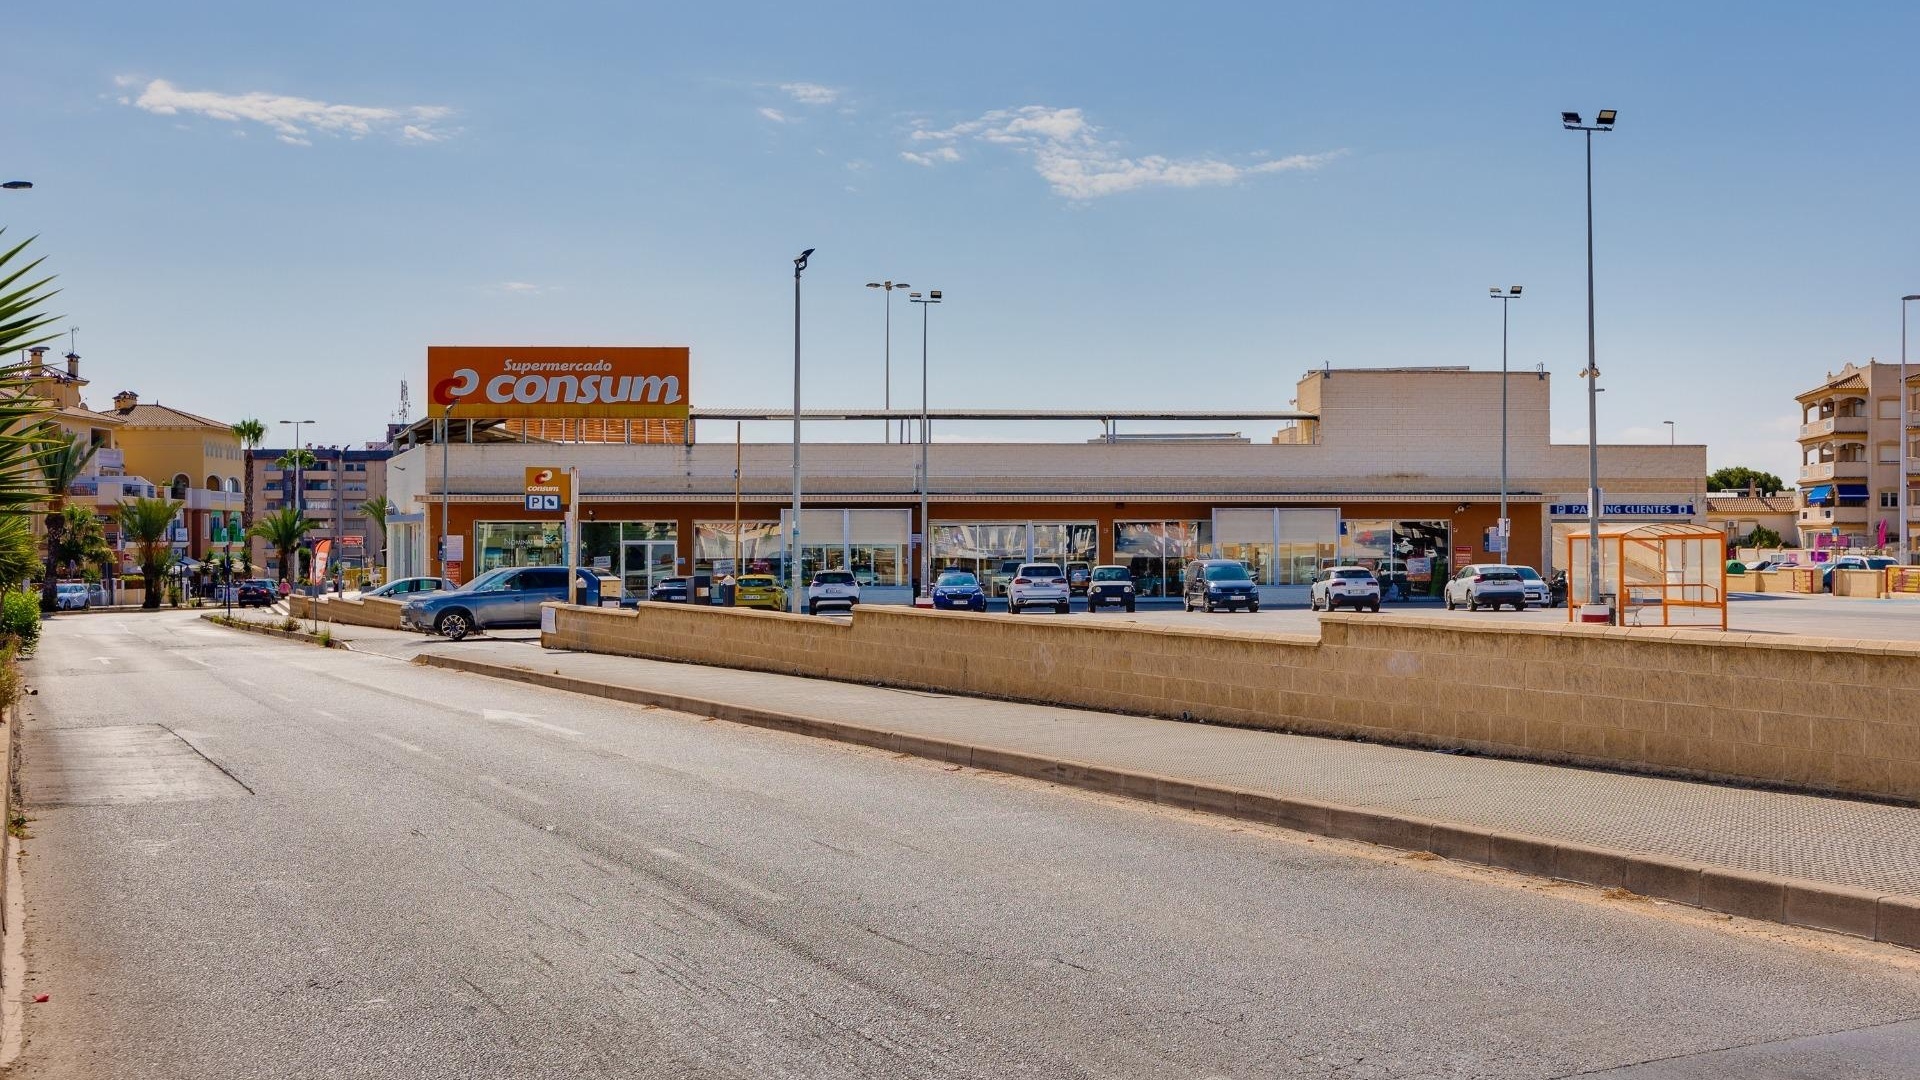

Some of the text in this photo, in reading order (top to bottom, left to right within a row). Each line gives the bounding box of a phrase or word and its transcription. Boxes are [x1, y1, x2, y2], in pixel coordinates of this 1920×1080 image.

[503, 358, 613, 374] Supermercado
[485, 374, 682, 405] consum
[531, 497, 540, 507] P
[1572, 505, 1621, 514] PANG
[1624, 505, 1672, 514] CLIENTES
